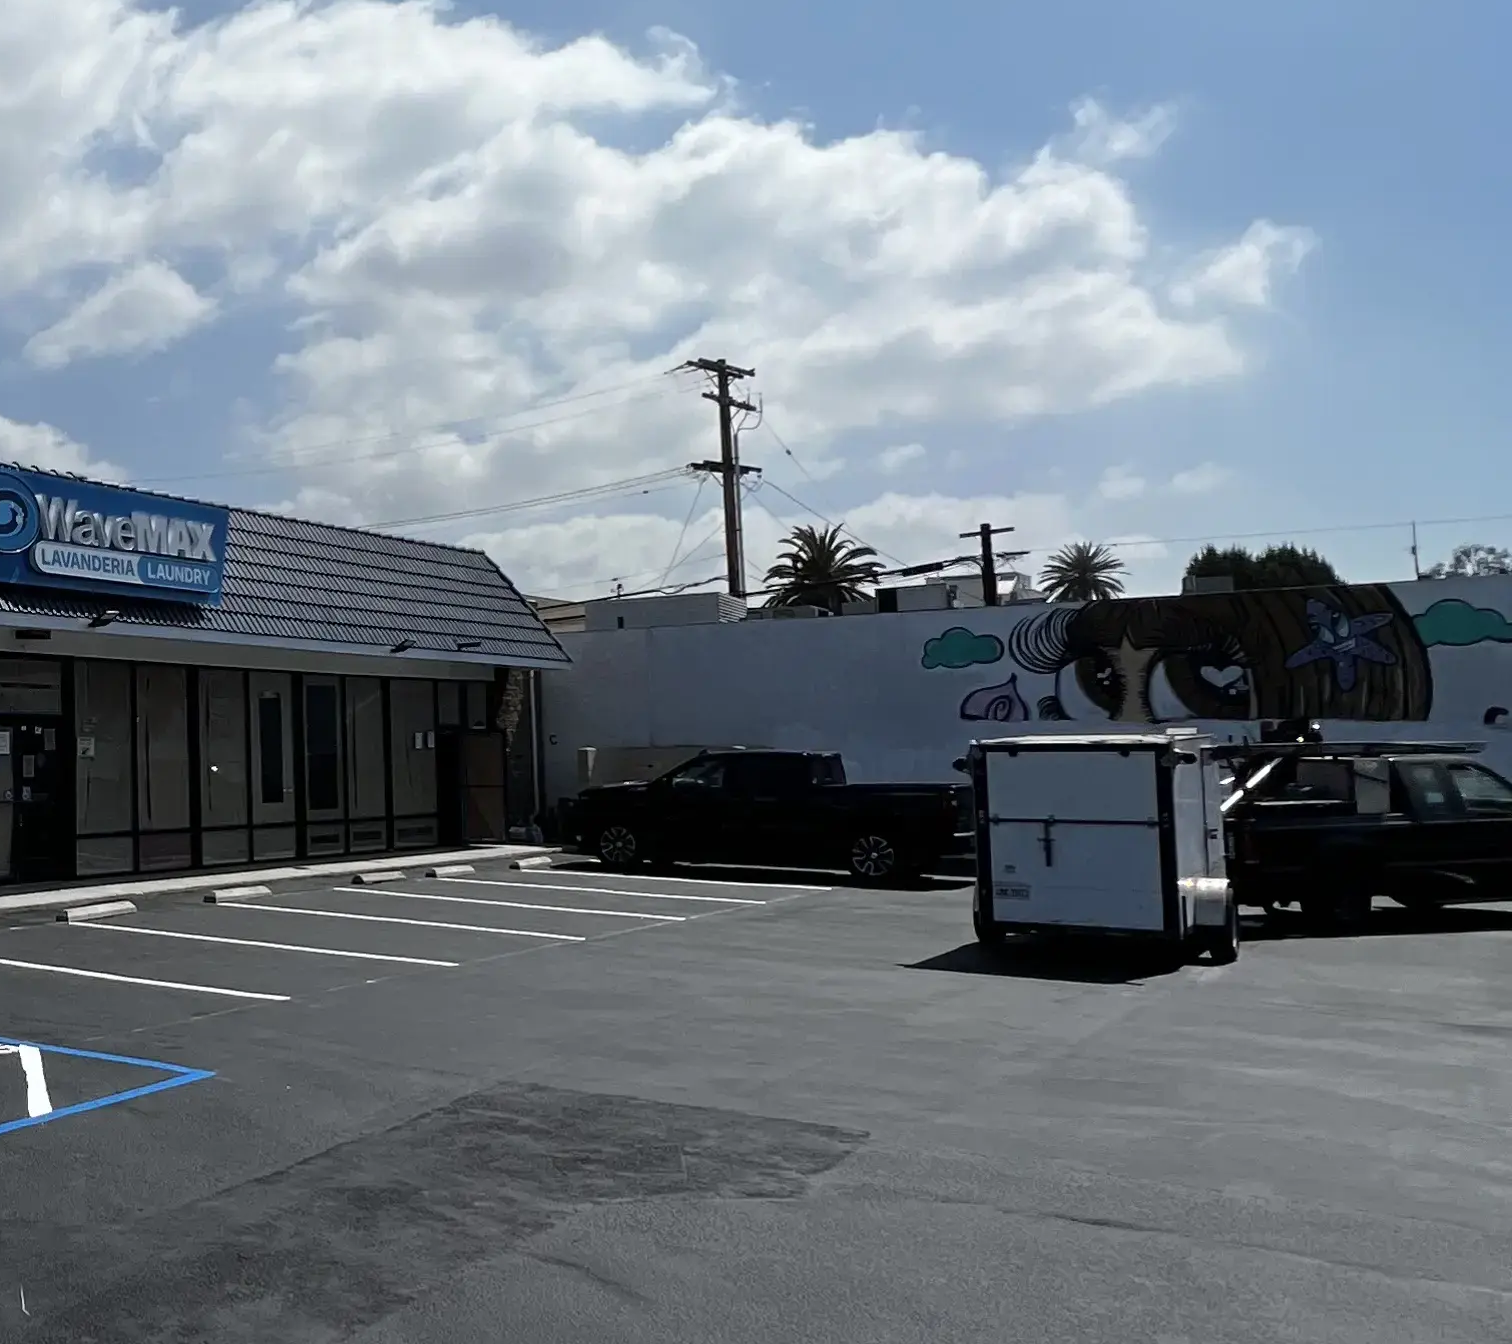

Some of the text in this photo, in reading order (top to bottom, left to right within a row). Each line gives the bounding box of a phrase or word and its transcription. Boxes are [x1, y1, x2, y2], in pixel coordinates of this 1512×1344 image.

[36, 493, 216, 561] WaveMAX
[41, 548, 135, 577] LAVANDERIA
[147, 566, 211, 586] LAUNDRY
